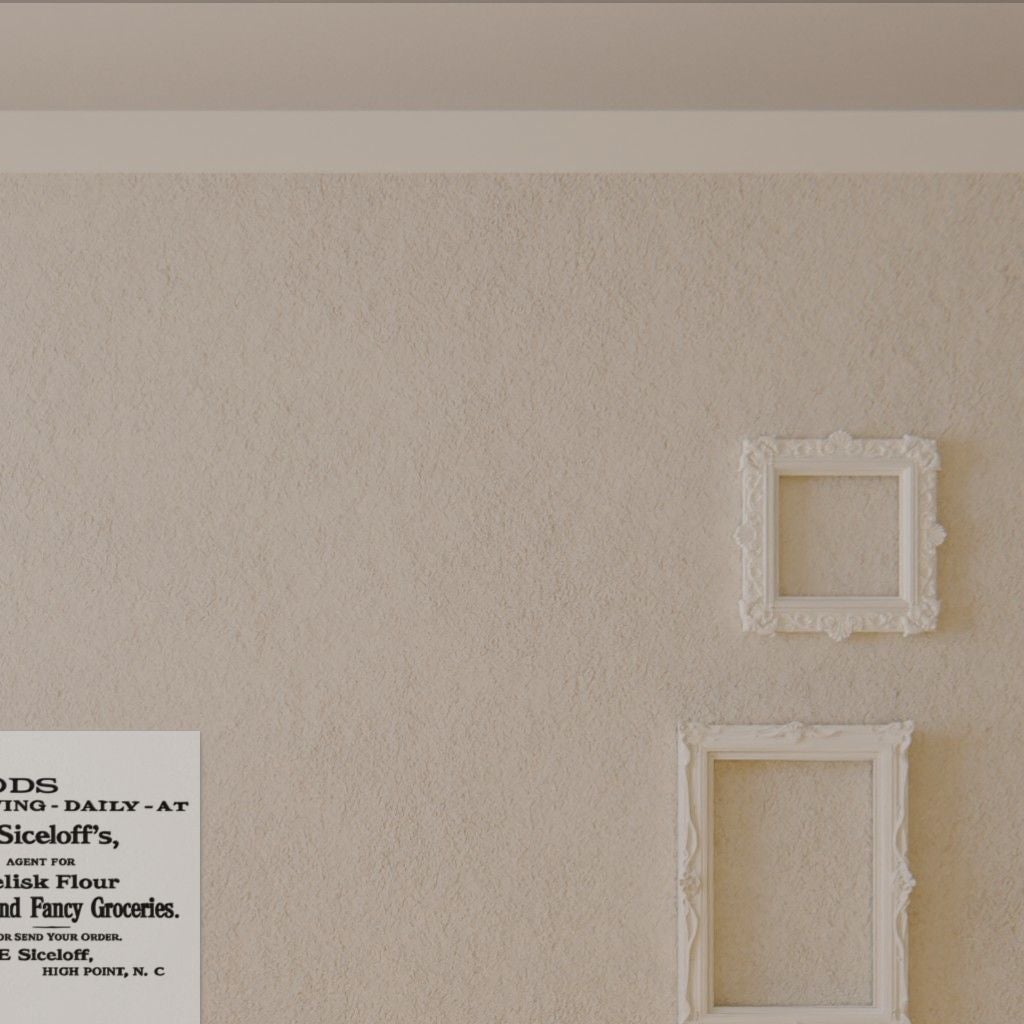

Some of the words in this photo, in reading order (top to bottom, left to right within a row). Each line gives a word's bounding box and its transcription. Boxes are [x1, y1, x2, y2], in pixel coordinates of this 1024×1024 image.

[63, 799, 140, 812] DAILY
[156, 800, 190, 812] AT
[5, 857, 48, 867] AGENT
[51, 857, 76, 867] FOR
[55, 873, 121, 890] Flour
[29, 895, 84, 924] Fancy
[90, 895, 180, 919] Groceries.
[14, 932, 44, 942] SEND
[46, 932, 79, 942] YOUR
[80, 932, 123, 942] ORDER.
[17, 948, 94, 963] Siceloff,
[42, 966, 80, 978] HIGH
[83, 966, 129, 979] POINT,
[132, 966, 149, 977] N.
[153, 966, 166, 977] C
